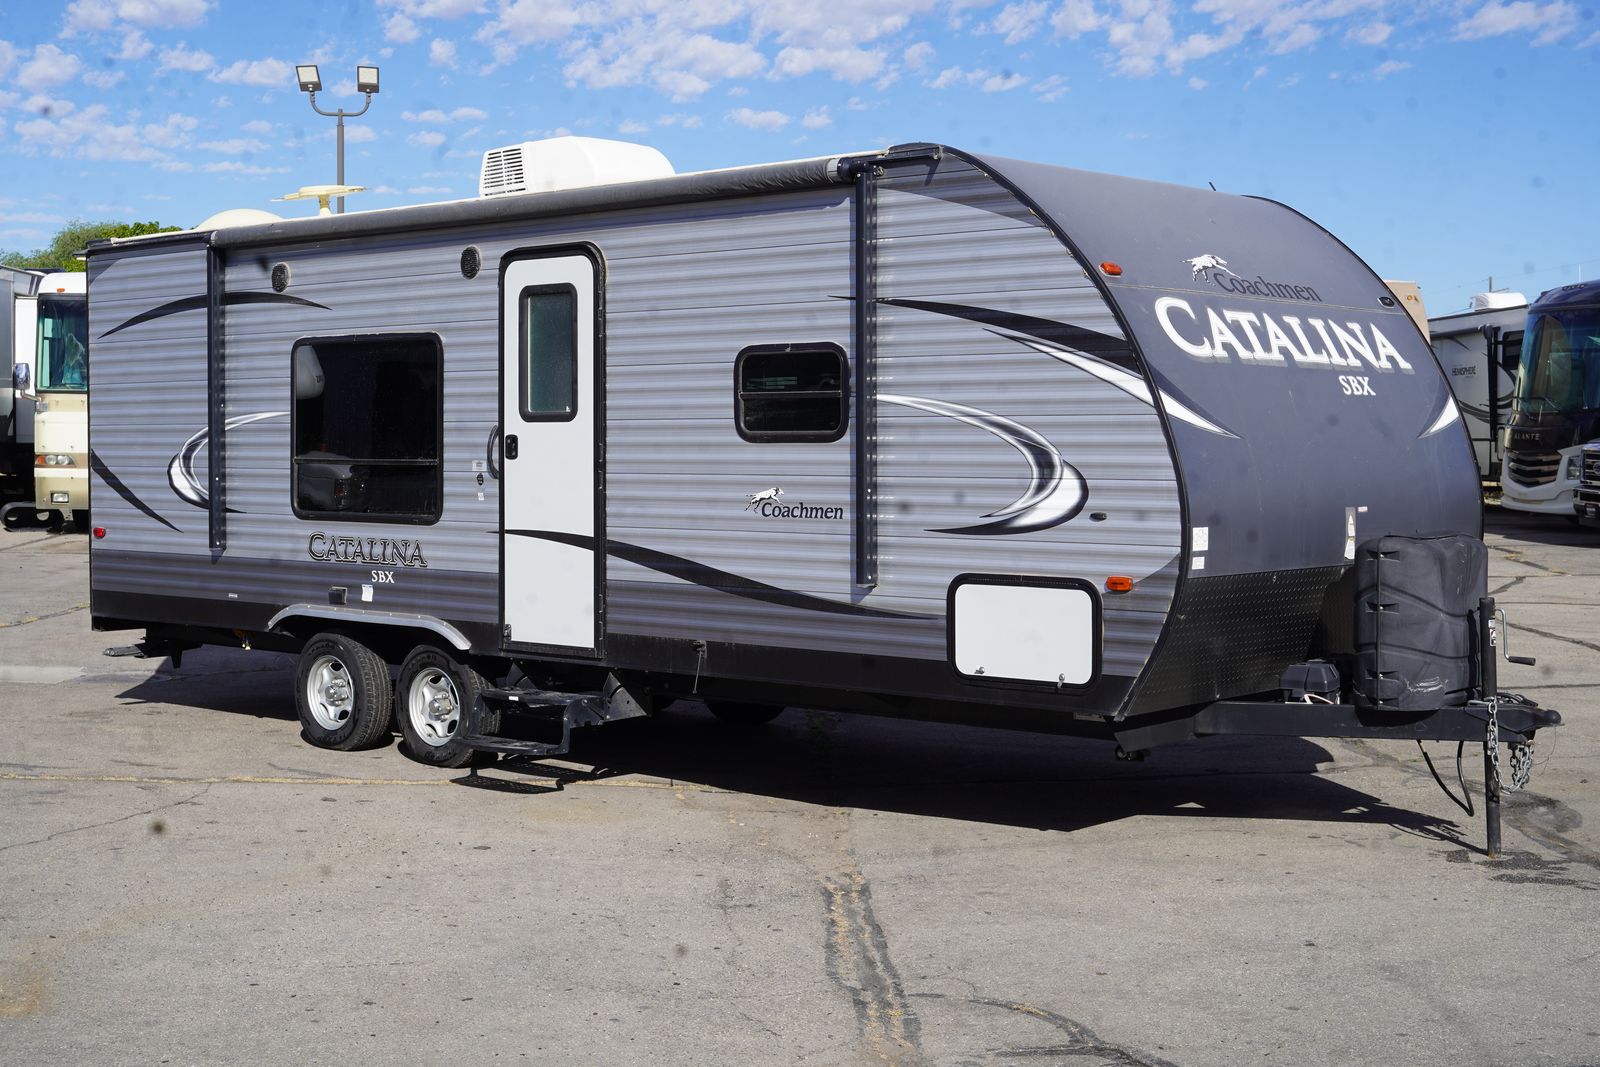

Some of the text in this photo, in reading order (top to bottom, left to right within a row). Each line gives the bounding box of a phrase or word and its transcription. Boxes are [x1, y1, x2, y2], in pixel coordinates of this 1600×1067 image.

[1214, 272, 1322, 302] Coachmen
[1155, 296, 1414, 372] CATALINA
[1338, 375, 1376, 396] SBX
[761, 502, 843, 520] Coachmen
[308, 531, 428, 567] CATALINA
[371, 570, 395, 583] SBX
